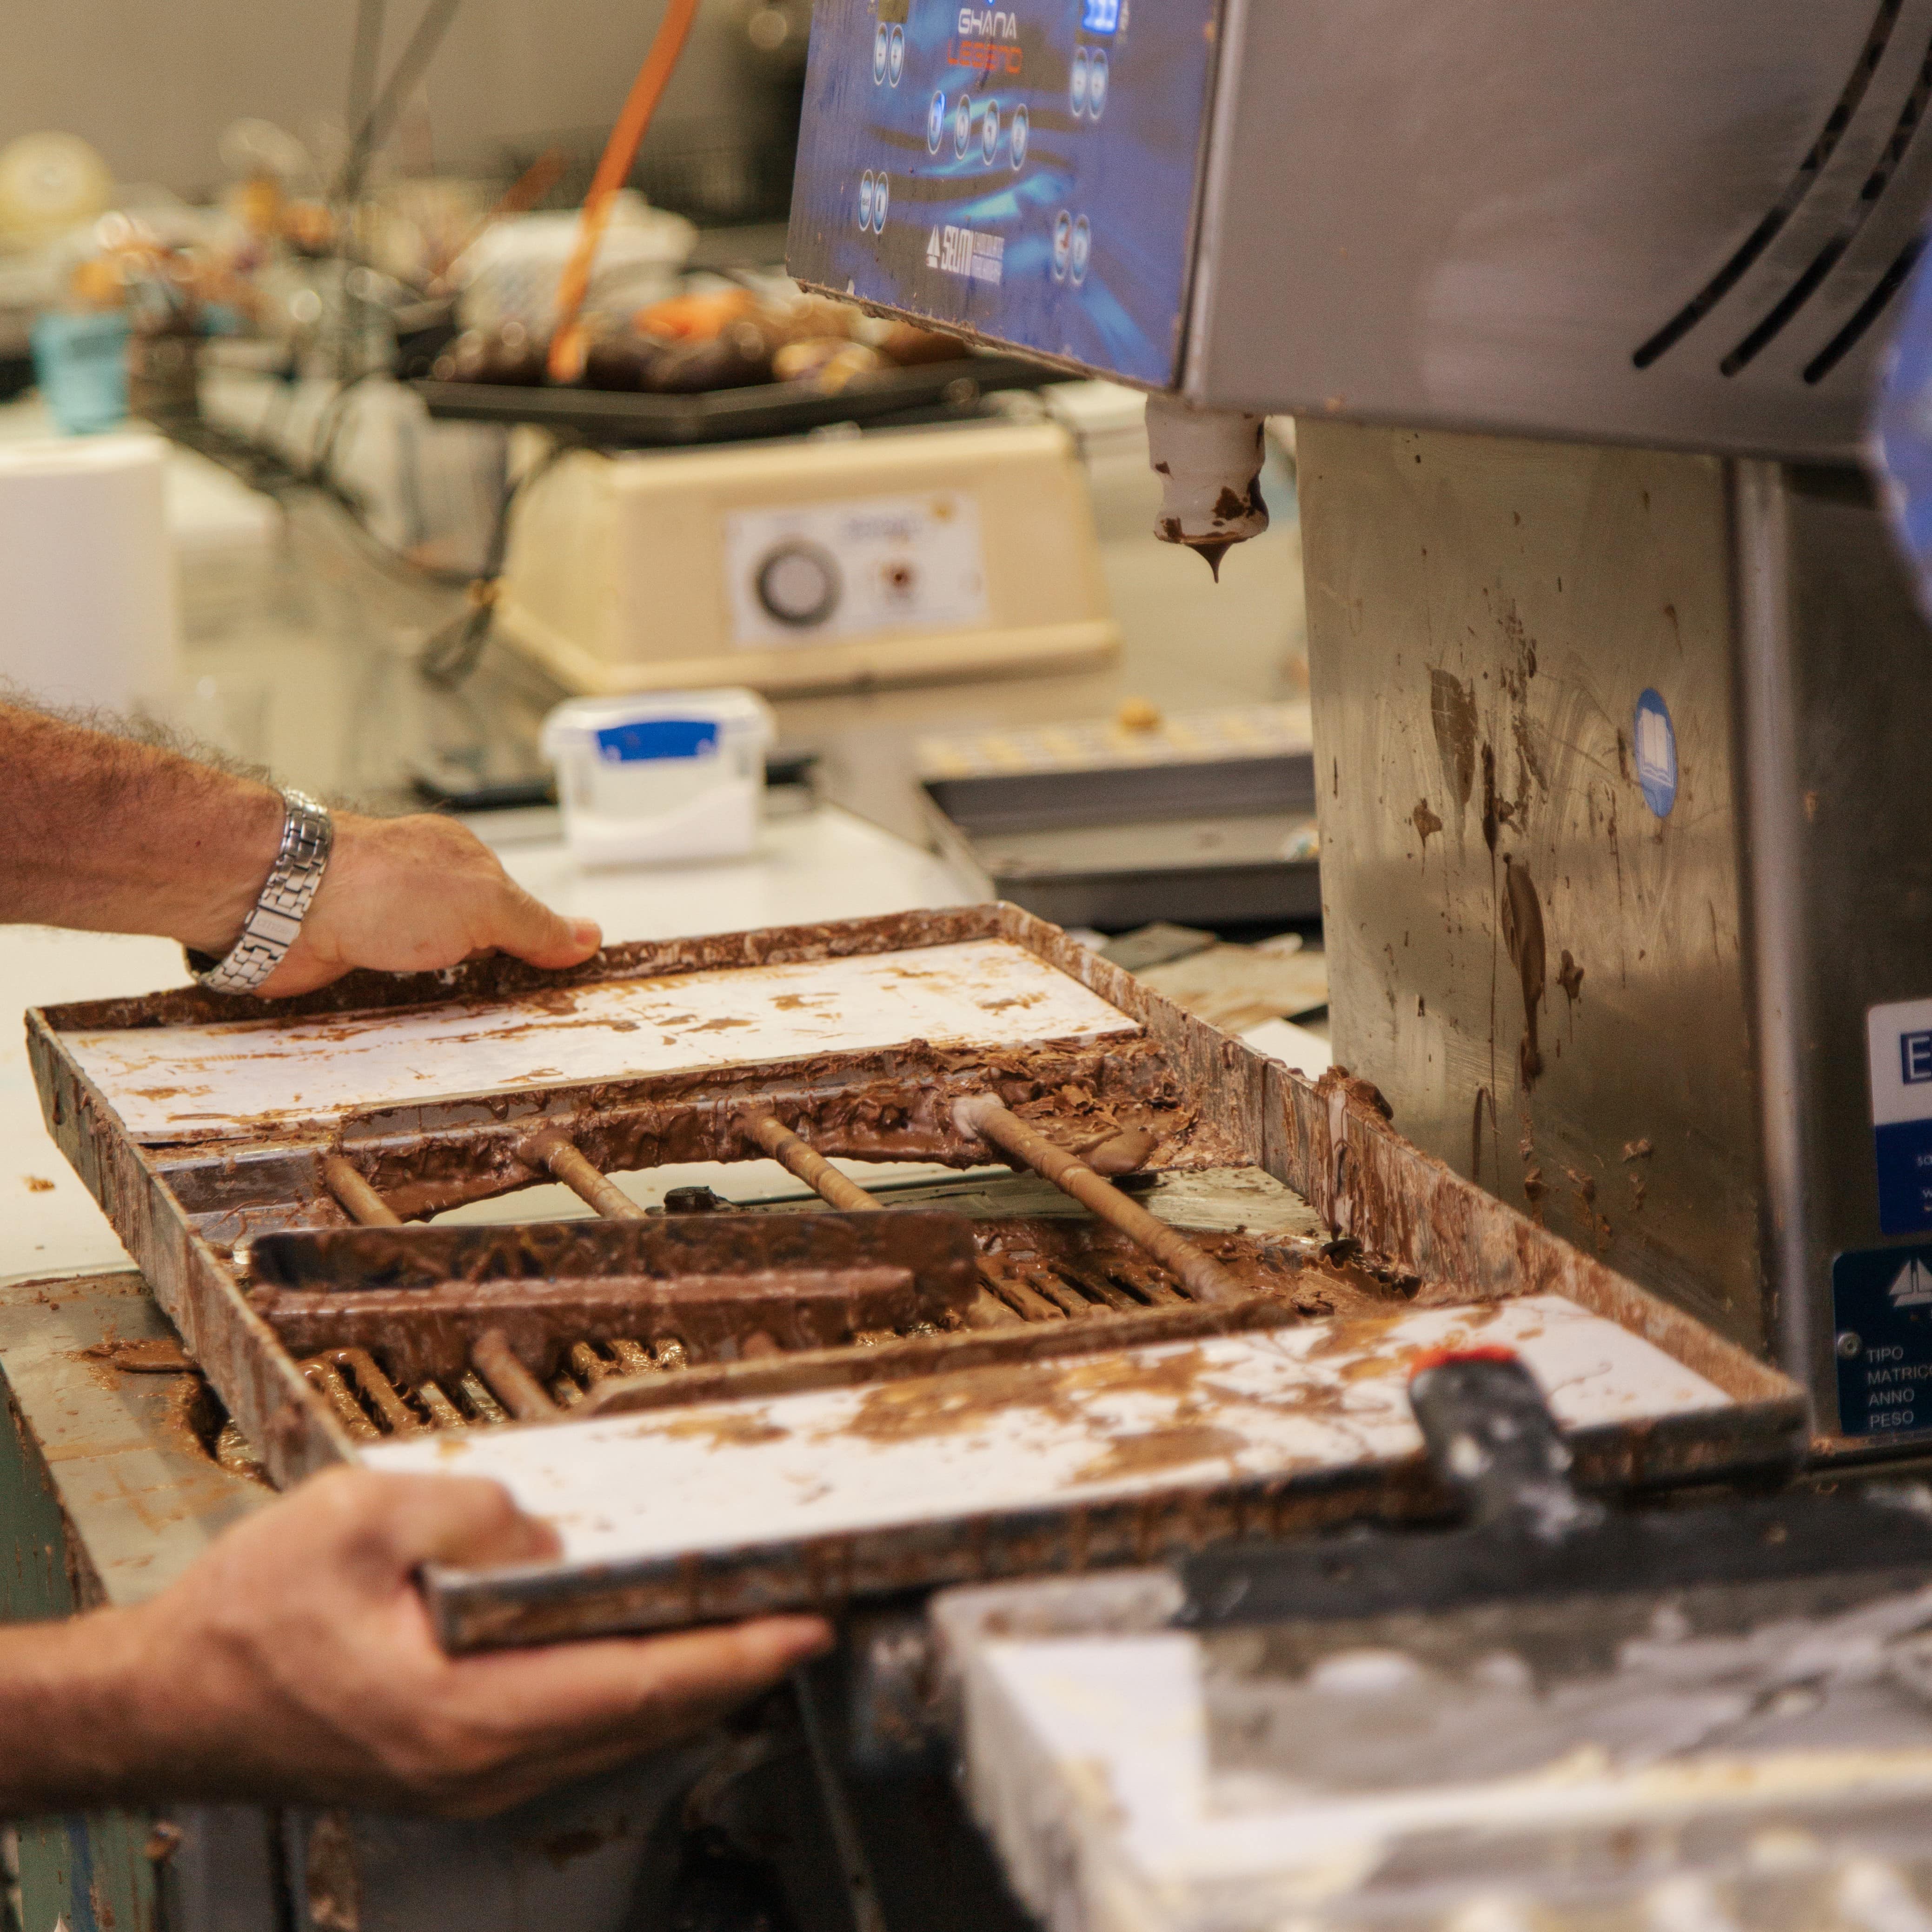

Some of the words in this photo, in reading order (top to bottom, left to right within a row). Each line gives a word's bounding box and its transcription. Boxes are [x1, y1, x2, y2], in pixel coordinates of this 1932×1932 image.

[958, 8, 1016, 39] GHANA
[947, 38, 1022, 73] LEGEND
[1867, 1346, 1904, 1363] TIPO
[1868, 1364, 1932, 1385] MATRIC
[1869, 1388, 1915, 1407] ANNO
[1870, 1410, 1914, 1428] PESO
